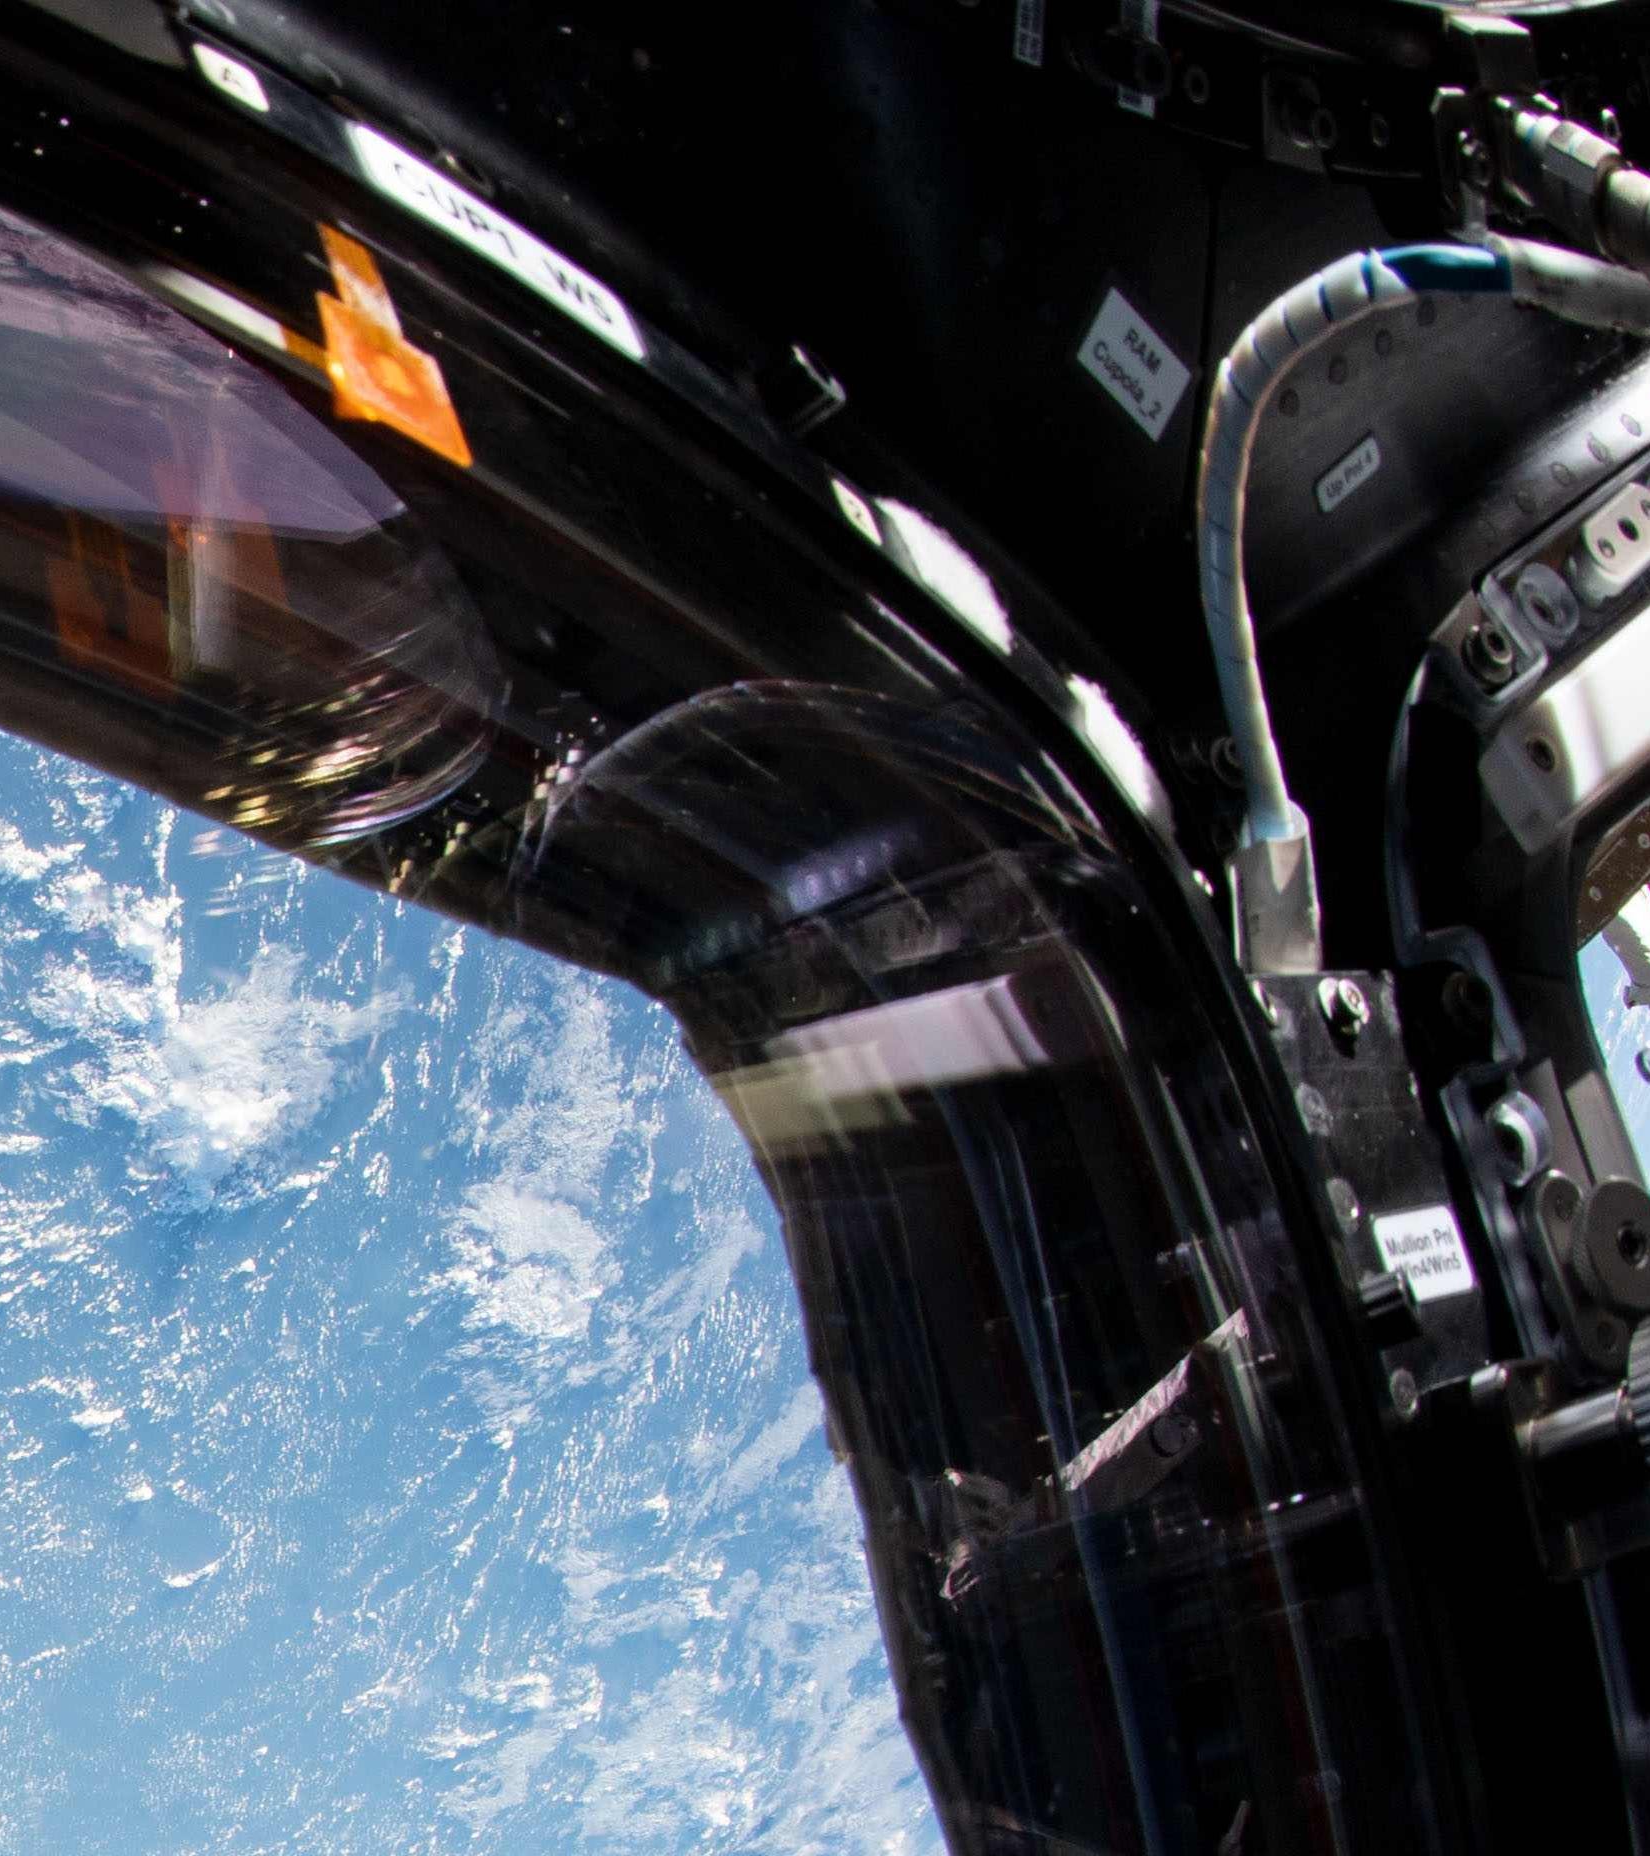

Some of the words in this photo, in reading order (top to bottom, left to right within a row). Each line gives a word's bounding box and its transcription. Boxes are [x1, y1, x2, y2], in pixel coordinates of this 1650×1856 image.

[1125, 328, 1162, 374] RAM
[1386, 1232, 1432, 1256] Mullion
[1434, 1226, 1454, 1246] Pnl
